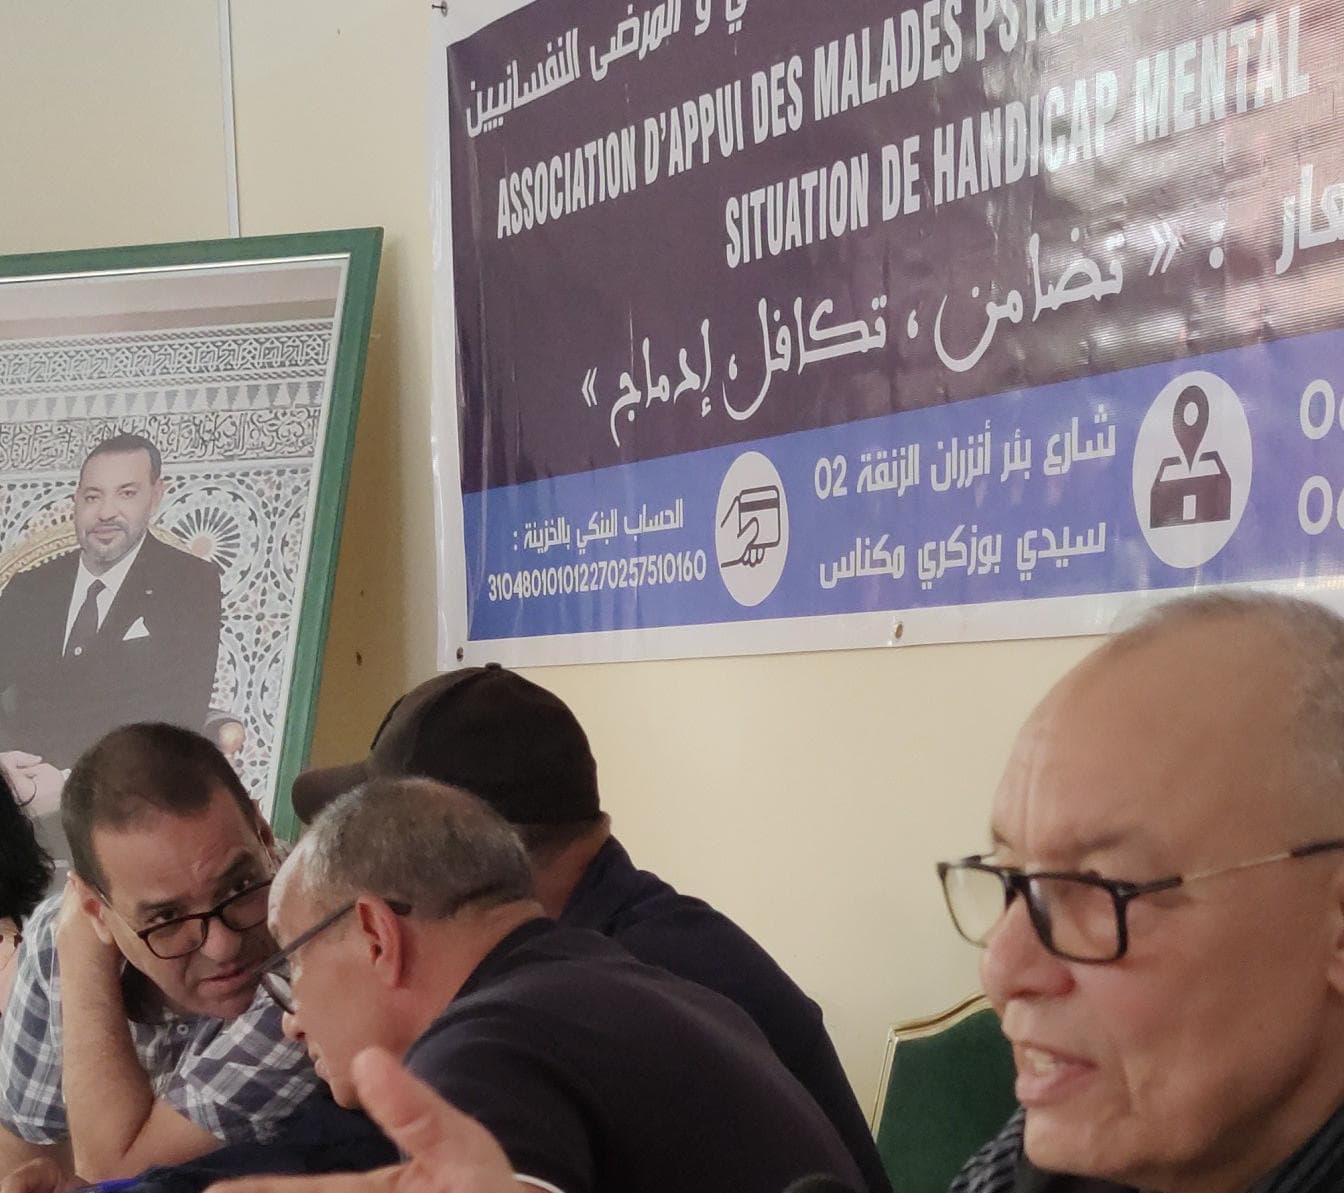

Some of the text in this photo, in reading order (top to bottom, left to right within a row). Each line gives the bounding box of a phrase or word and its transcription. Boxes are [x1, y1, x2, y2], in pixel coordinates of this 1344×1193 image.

[466, 27, 581, 138] النفسانيين
[497, 125, 637, 239] ASSOCIATION
[643, 79, 745, 185] D'APPUI
[751, 55, 803, 144] DES
[813, 0, 963, 121] MALADES
[725, 4, 1310, 269] SITUATION DE HANDICAP MENTAL
[1001, 427, 1032, 482] بئر
[1043, 402, 1116, 476] شارع
[814, 454, 848, 500] 02
[856, 443, 920, 498] الزنقة
[523, 516, 571, 554] بالخزينة
[576, 508, 618, 555] البنكي
[623, 498, 684, 542] الحساب
[487, 548, 707, 602] 310480101012270257510160
[819, 521, 1107, 591] سيدي بوزكري مكناس
